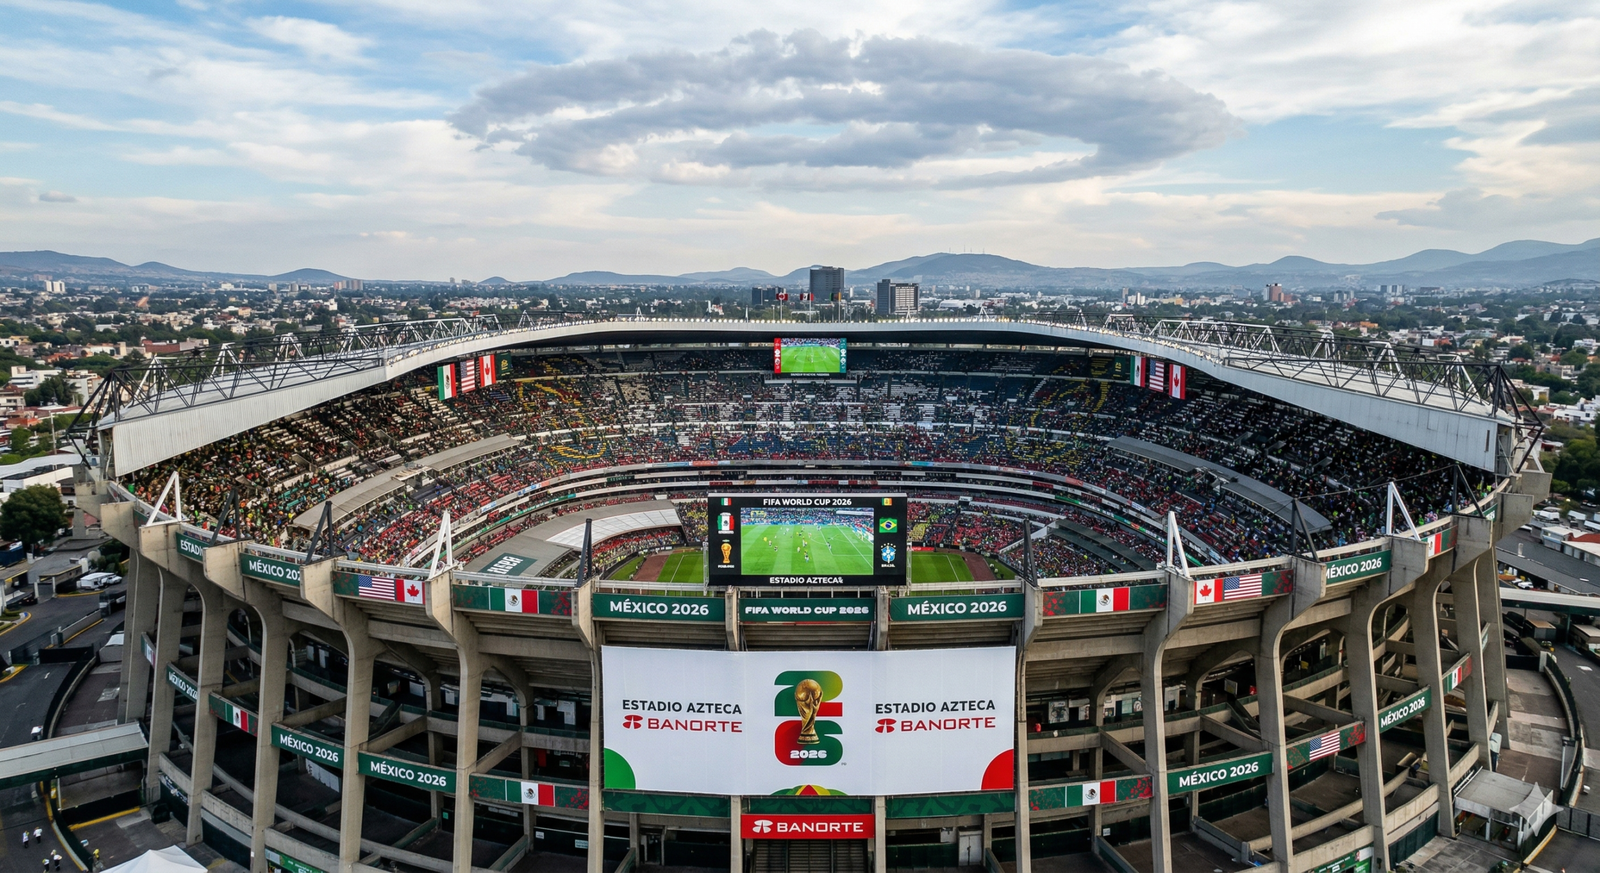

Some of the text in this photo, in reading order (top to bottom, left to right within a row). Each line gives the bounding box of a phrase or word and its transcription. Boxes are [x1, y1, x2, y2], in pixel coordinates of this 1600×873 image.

[763, 498, 852, 506] FIFA WORLD CUP 2026
[248, 559, 284, 577] MÉXICO
[1360, 557, 1382, 572] 2026
[769, 576, 804, 584] ESTADIO
[609, 598, 710, 616] MÉXICO 2026
[744, 606, 869, 614] FIFA WORLD CUP 2026
[907, 600, 1007, 615] MÉXICO 2026
[622, 699, 743, 714] ESTADIO AZTECA
[875, 699, 996, 714] ESTADIO AZTECA
[1380, 696, 1426, 728] MÉXICO 2026
[647, 718, 743, 733] BANORTE
[901, 717, 996, 732] BANORTE
[279, 733, 339, 763] MÉXICO 2026
[789, 749, 827, 759] 2026
[370, 761, 447, 787] MÉXICO 2026
[1179, 761, 1259, 787] MÉXICO 2026
[777, 822, 864, 833] BANORTE
